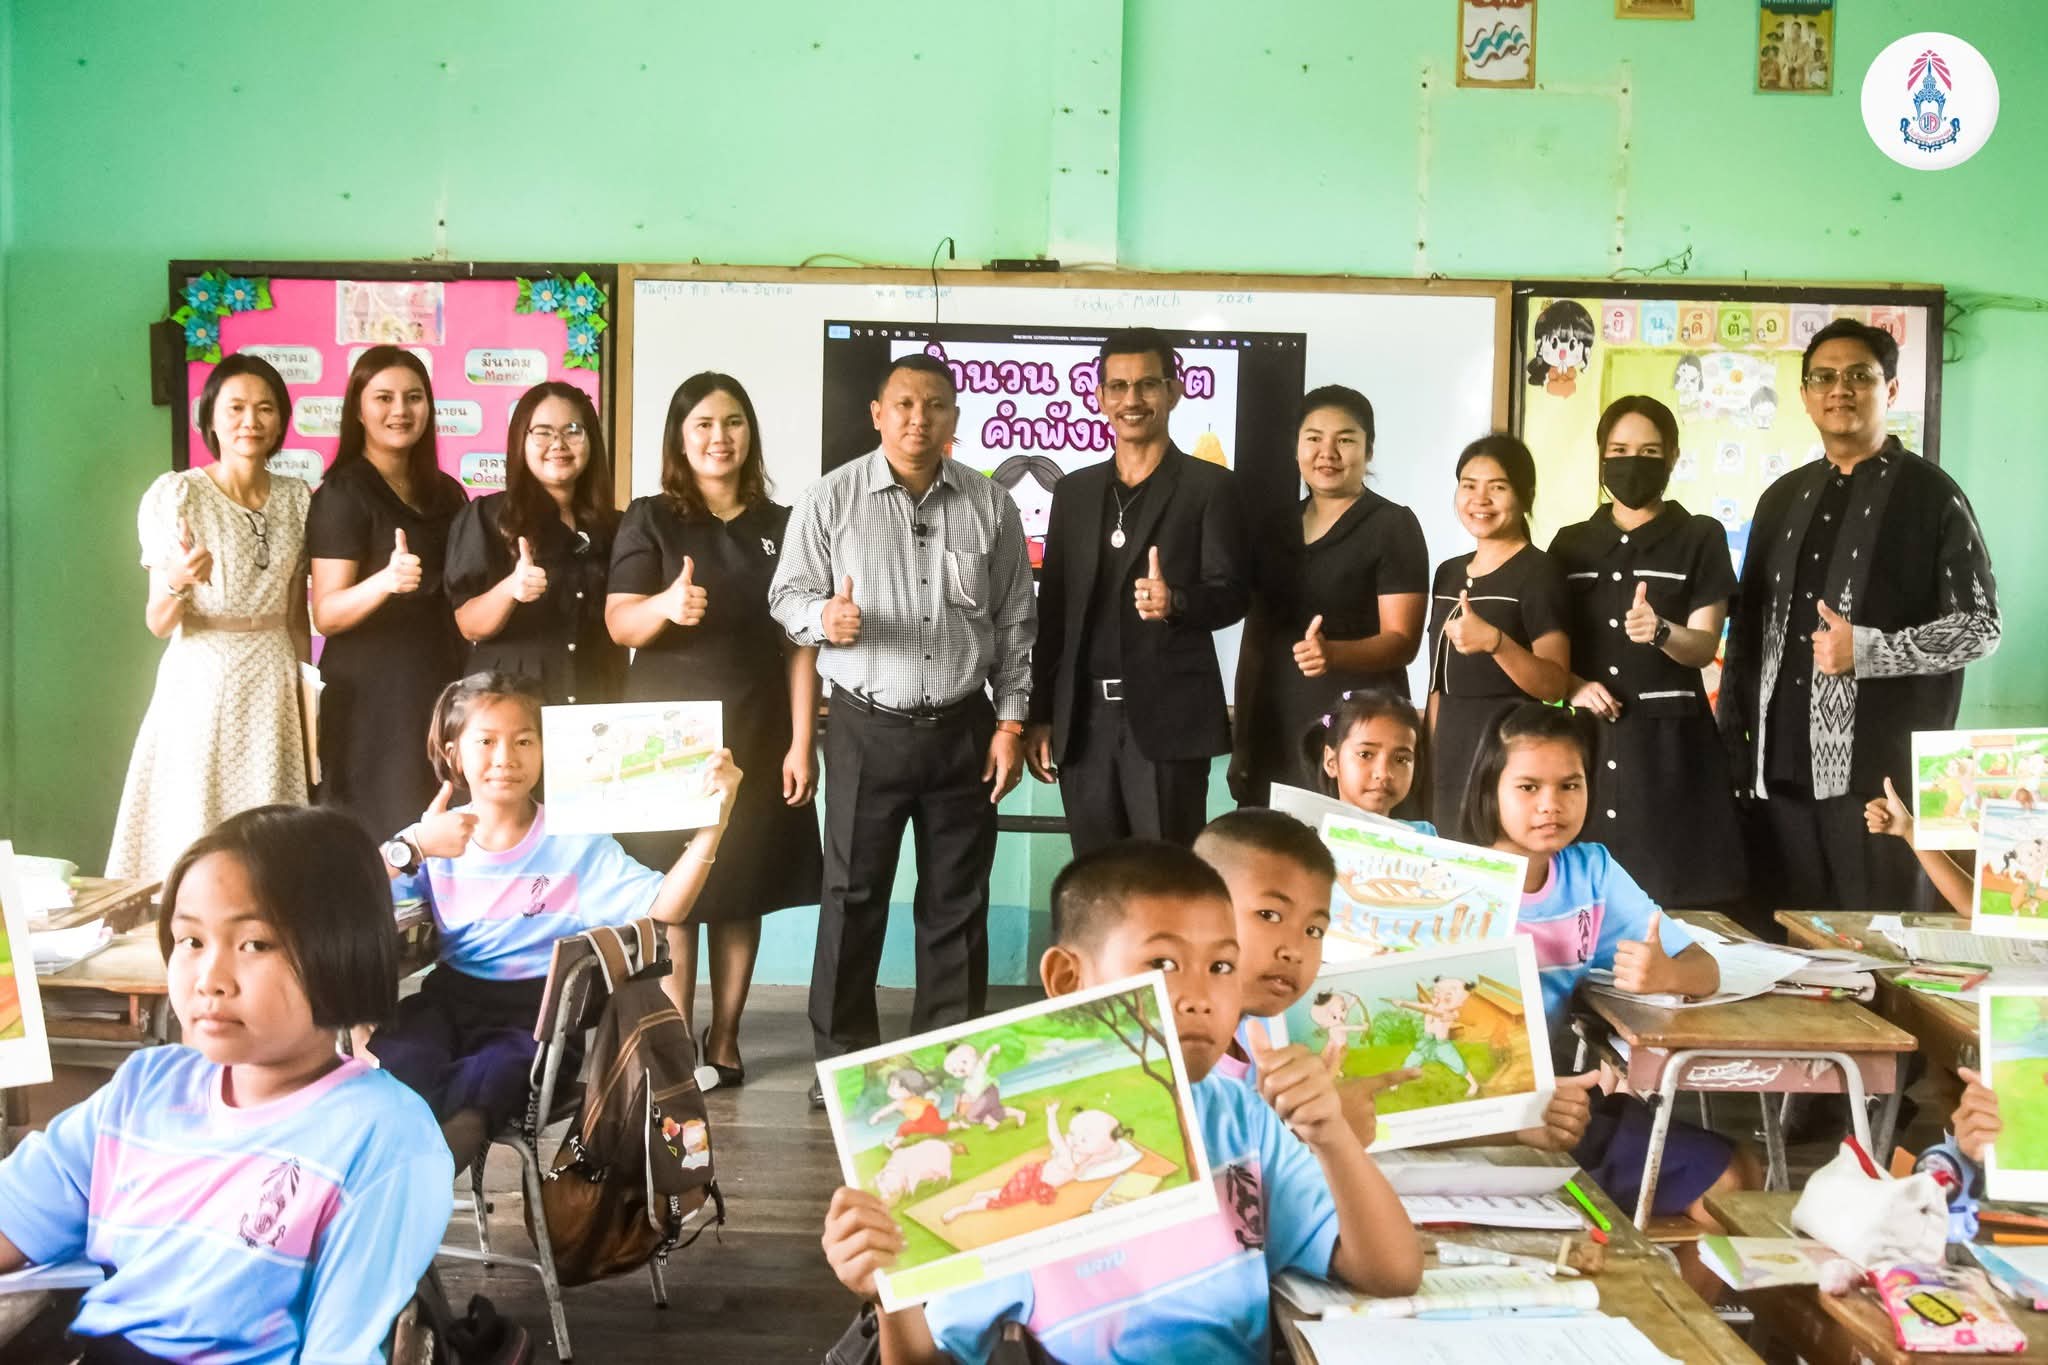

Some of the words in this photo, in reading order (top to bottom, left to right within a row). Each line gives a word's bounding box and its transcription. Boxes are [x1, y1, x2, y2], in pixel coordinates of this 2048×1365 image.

[481, 352, 530, 367] มีนาคม
[484, 370, 529, 381] March
